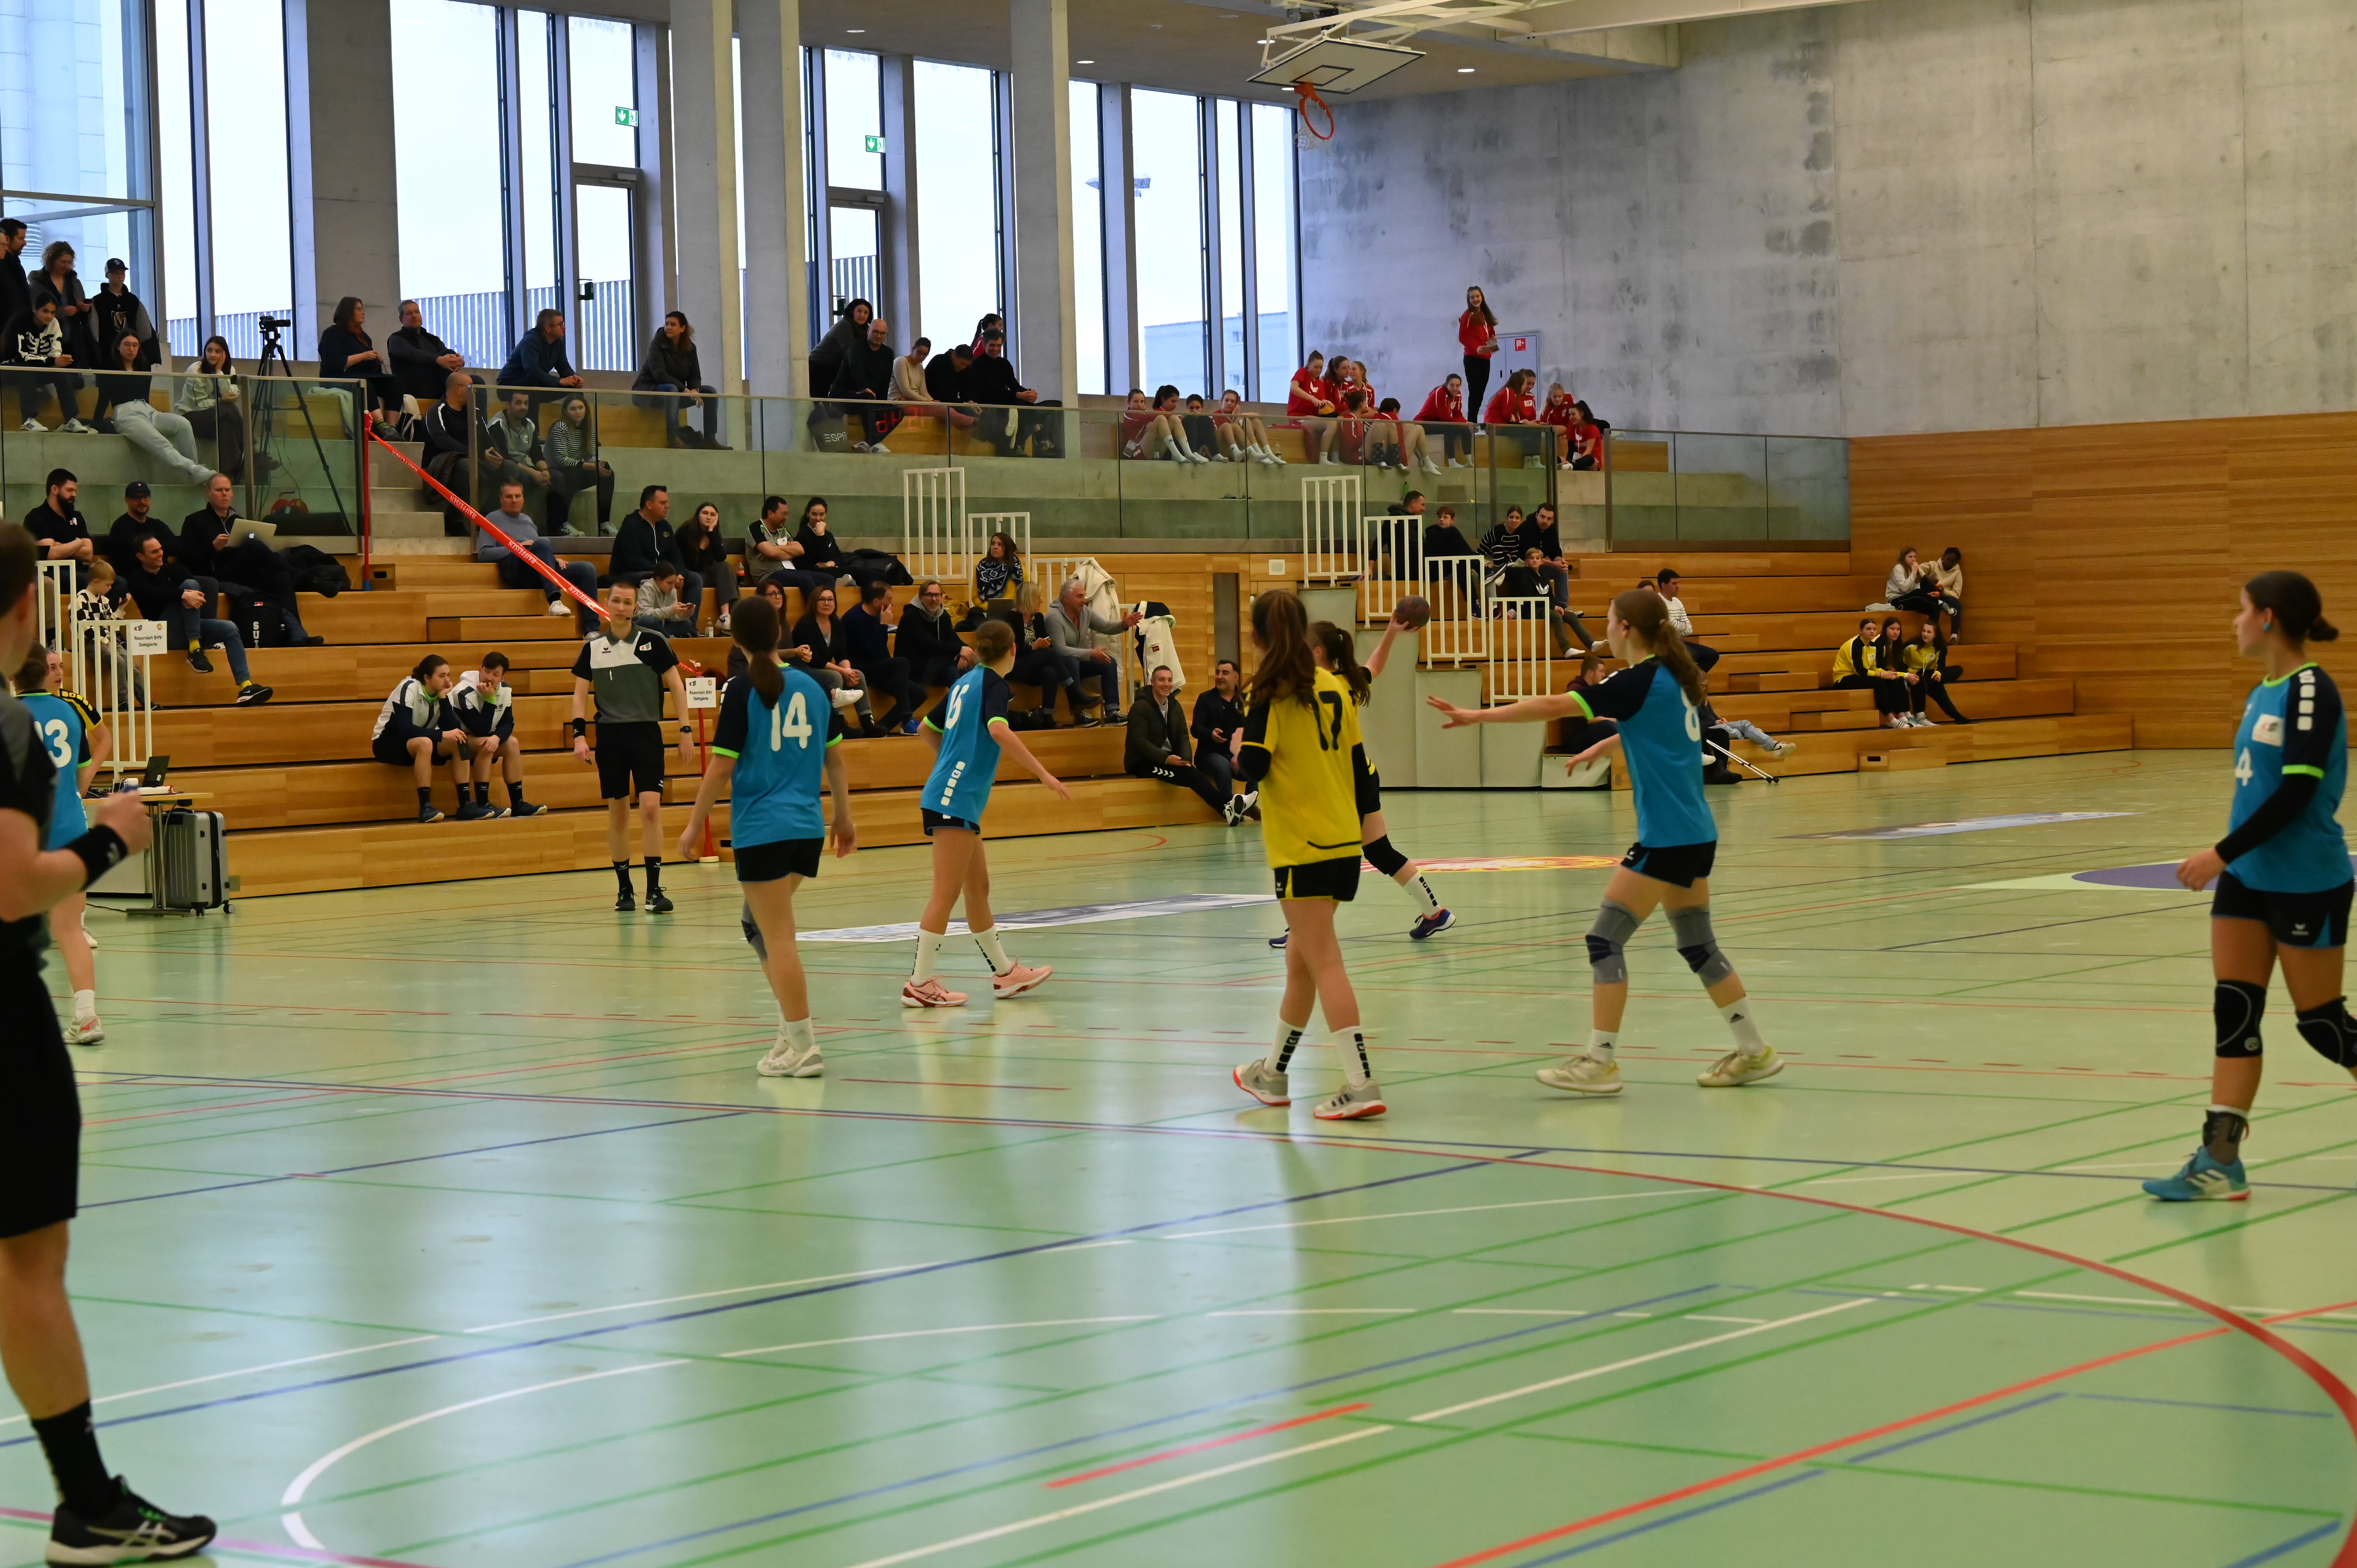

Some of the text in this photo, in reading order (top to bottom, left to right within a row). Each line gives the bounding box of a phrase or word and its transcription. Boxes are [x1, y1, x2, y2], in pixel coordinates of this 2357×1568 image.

[450, 495, 477, 519] RAIFFEISEN
[508, 540, 537, 564] RAIFFEISEN
[771, 692, 812, 751] 14
